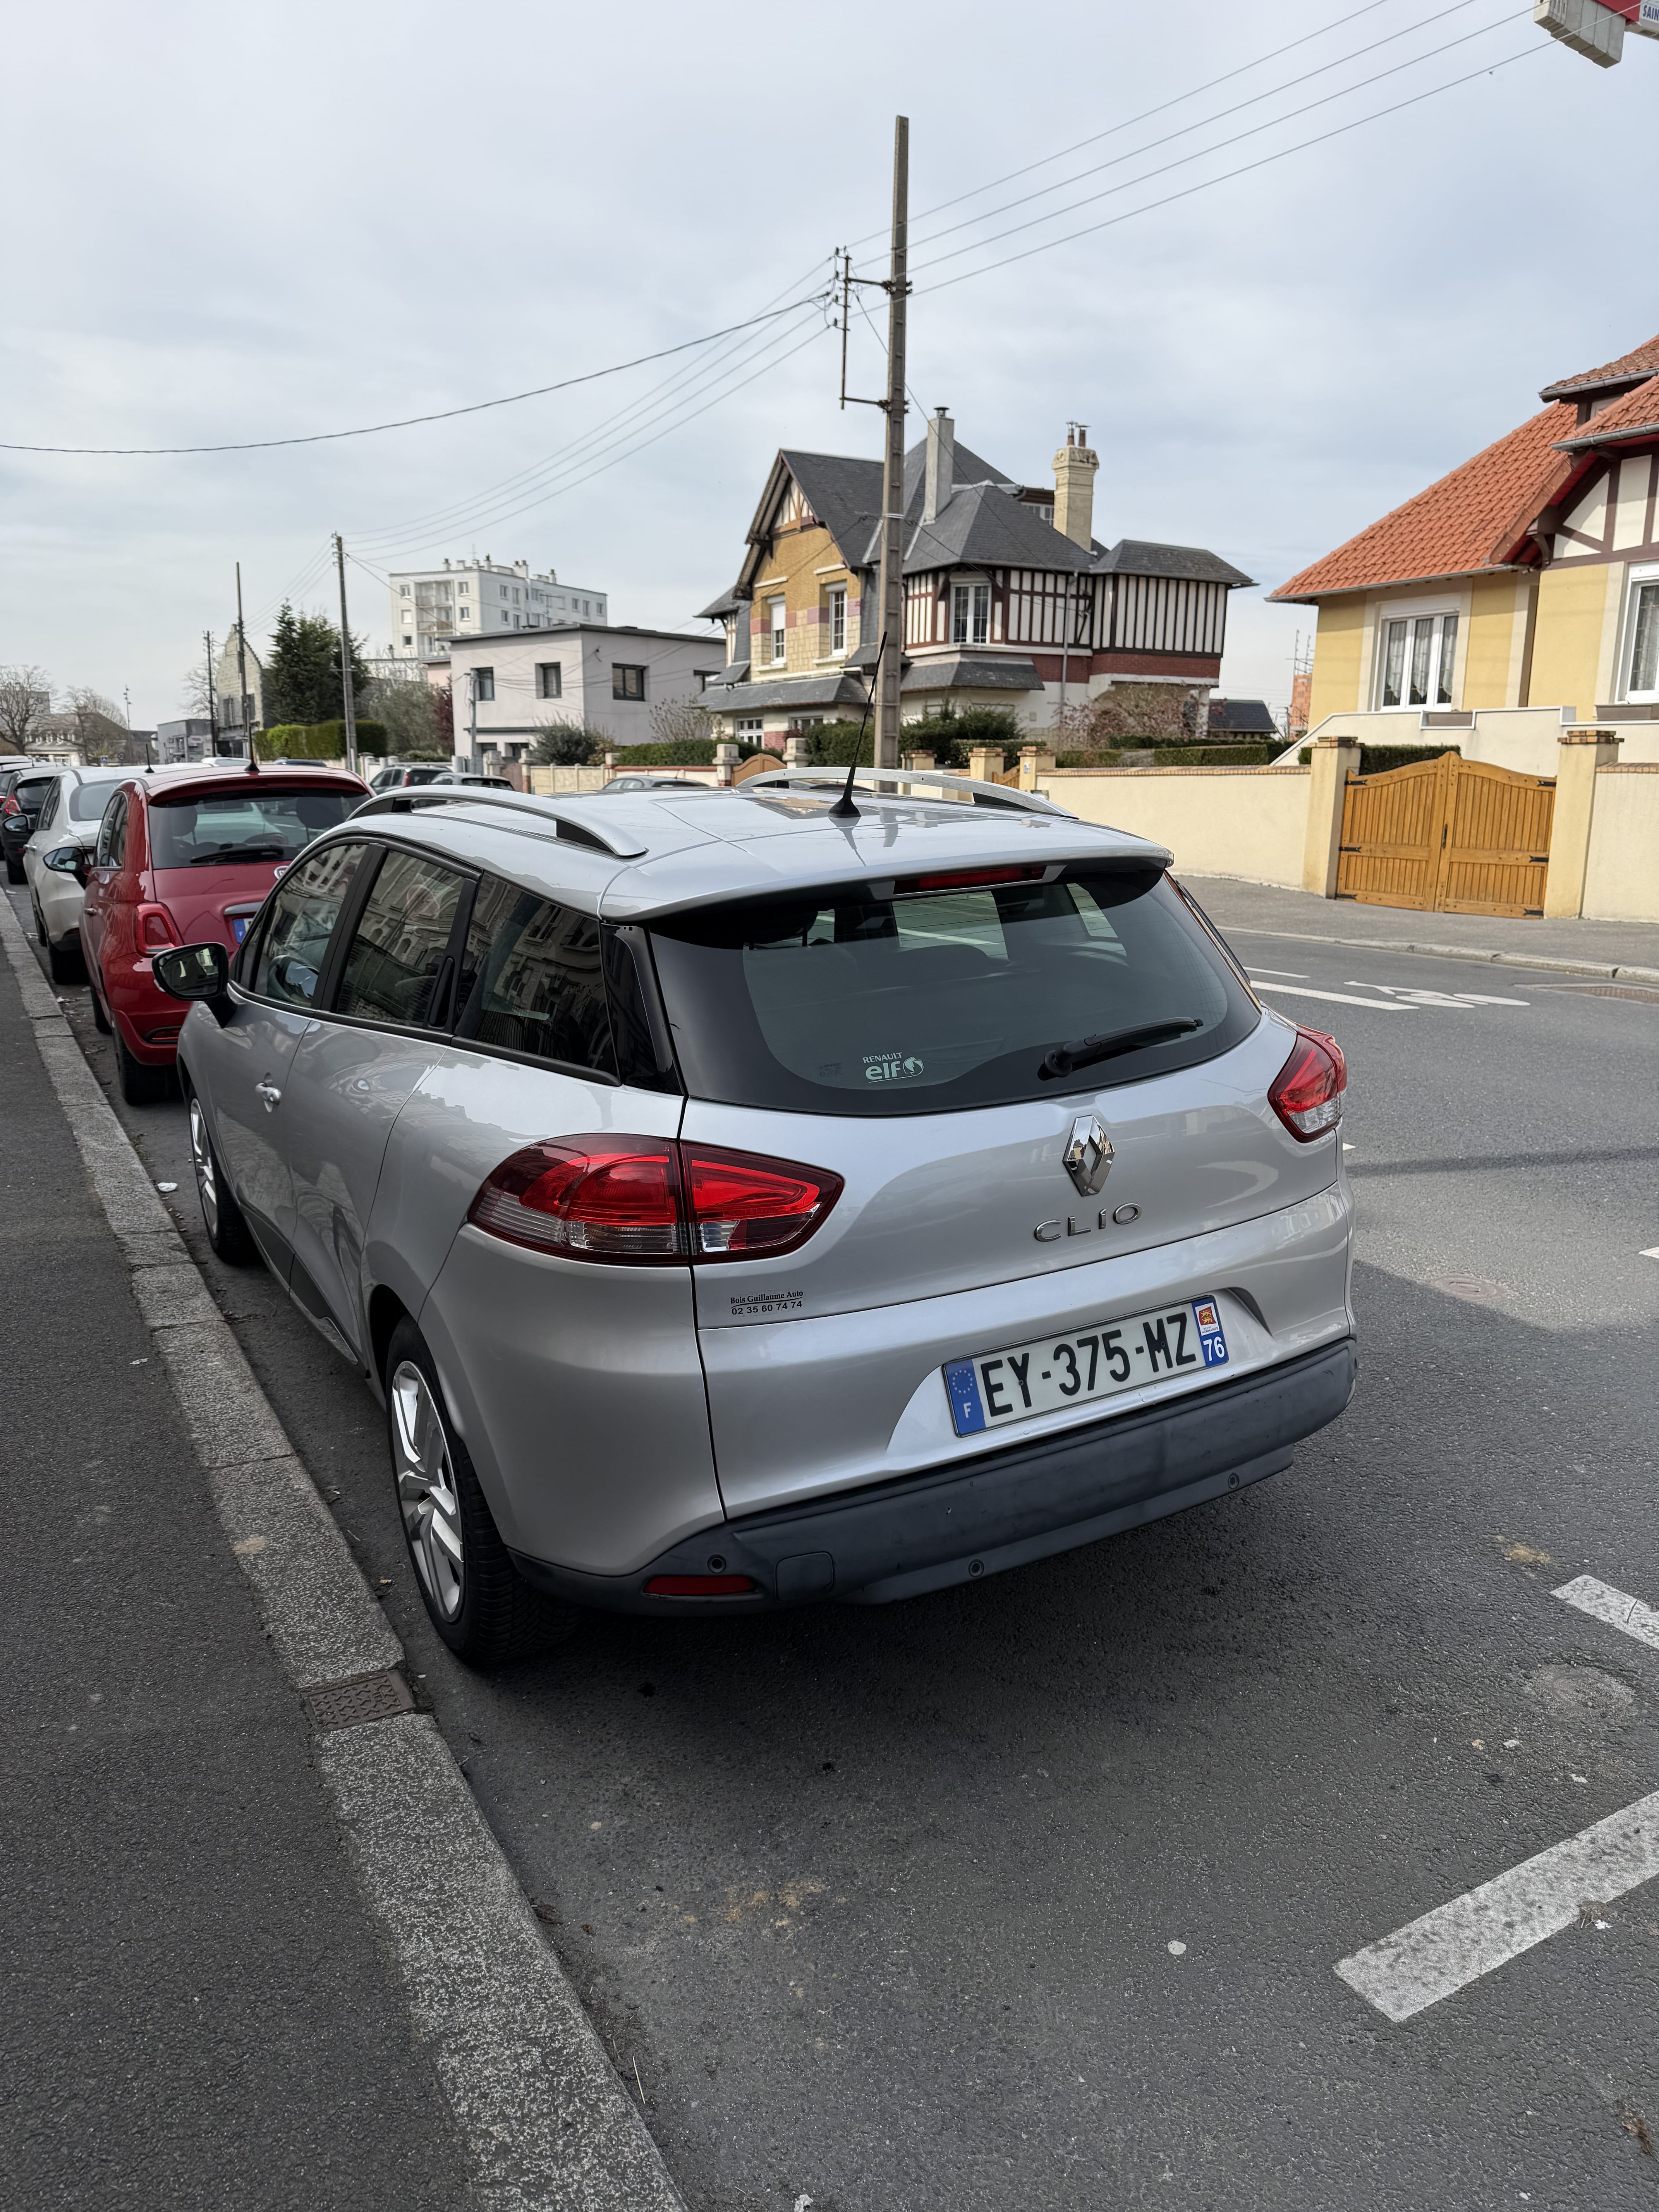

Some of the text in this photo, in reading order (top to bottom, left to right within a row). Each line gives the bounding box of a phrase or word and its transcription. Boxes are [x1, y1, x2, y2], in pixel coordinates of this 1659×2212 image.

[862, 1052, 902, 1063] RENAULT
[866, 1061, 901, 1080] elf
[1034, 1203, 1142, 1242] CLIO
[747, 1293, 785, 1302] Guillaume
[747, 1305, 758, 1314] 35
[776, 1302, 788, 1310] 74
[791, 1300, 802, 1309] 74
[1203, 1336, 1225, 1361] 76
[981, 1312, 1197, 1417] EY-375-MZ
[963, 1402, 972, 1419] F
